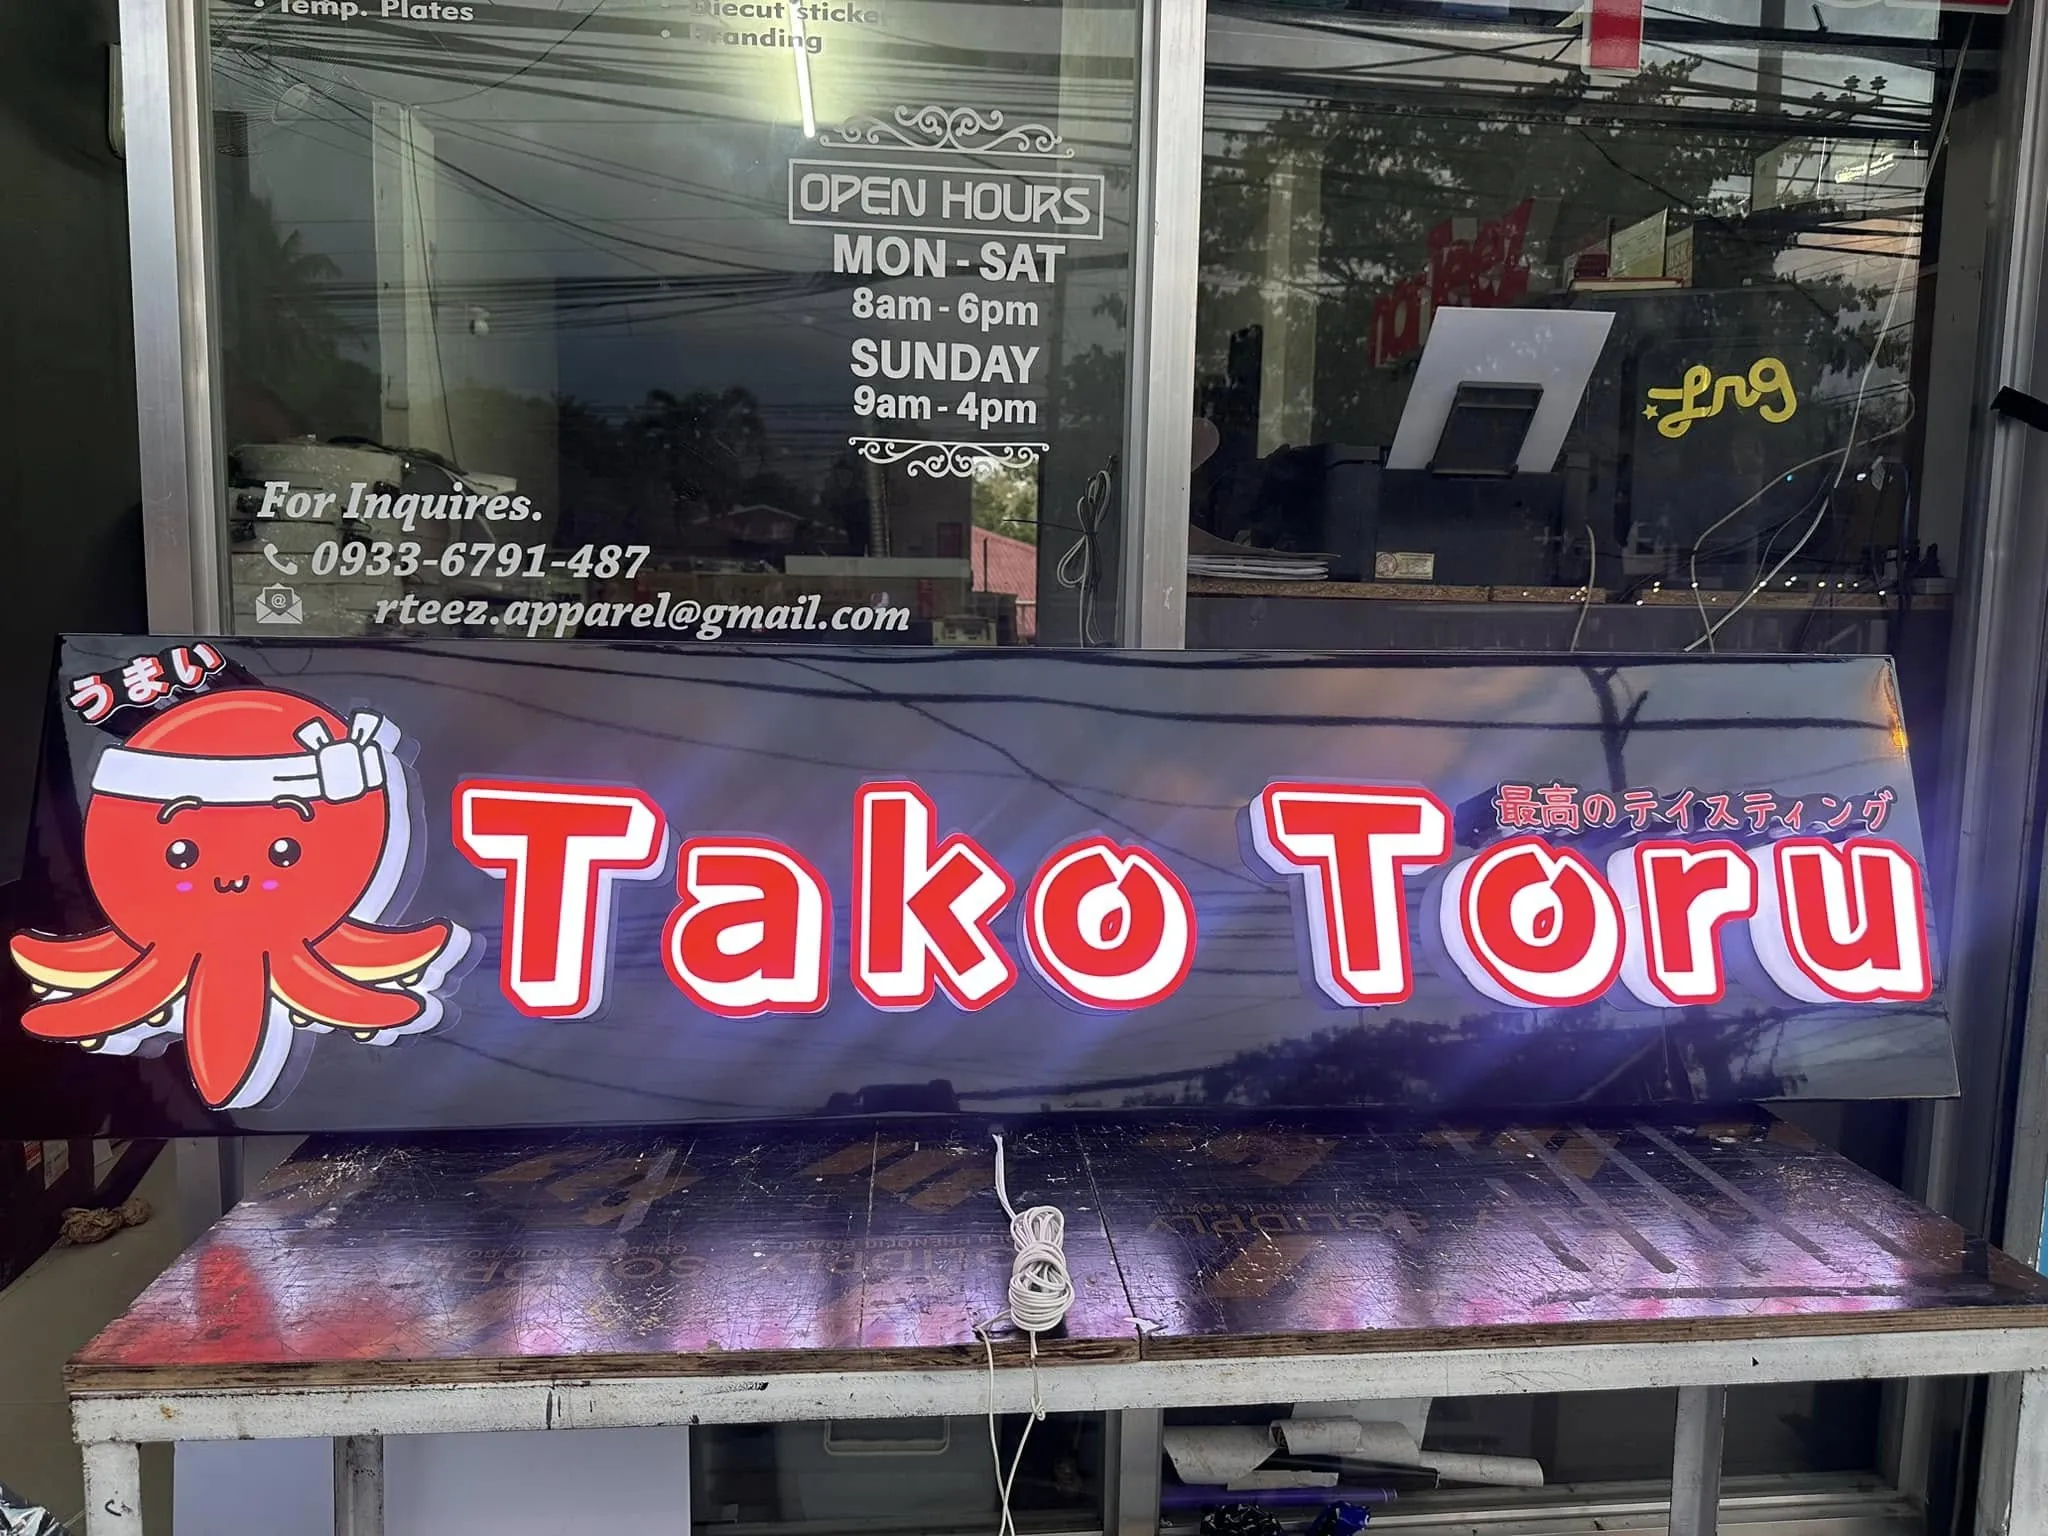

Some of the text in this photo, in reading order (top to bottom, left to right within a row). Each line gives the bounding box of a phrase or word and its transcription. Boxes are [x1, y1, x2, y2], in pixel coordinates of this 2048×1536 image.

[381, 0, 474, 21] Plates
[800, 173, 1091, 224] OPEN HOURS
[833, 234, 1066, 283] MON - SAT
[852, 287, 931, 321] 8am
[957, 292, 1038, 332] 6pm
[850, 338, 1040, 384] SUNDAY
[853, 385, 931, 420] 9am
[956, 391, 1037, 430] 4pm
[256, 481, 543, 532] For Inquires.
[311, 541, 651, 579] 0933-6791-487
[375, 591, 910, 640] rteez.apparel@gmail.com
[70, 643, 222, 720] うまい
[1496, 783, 1895, 831] 最高のテイスティング
[452, 780, 1933, 1018] Tako Toru
